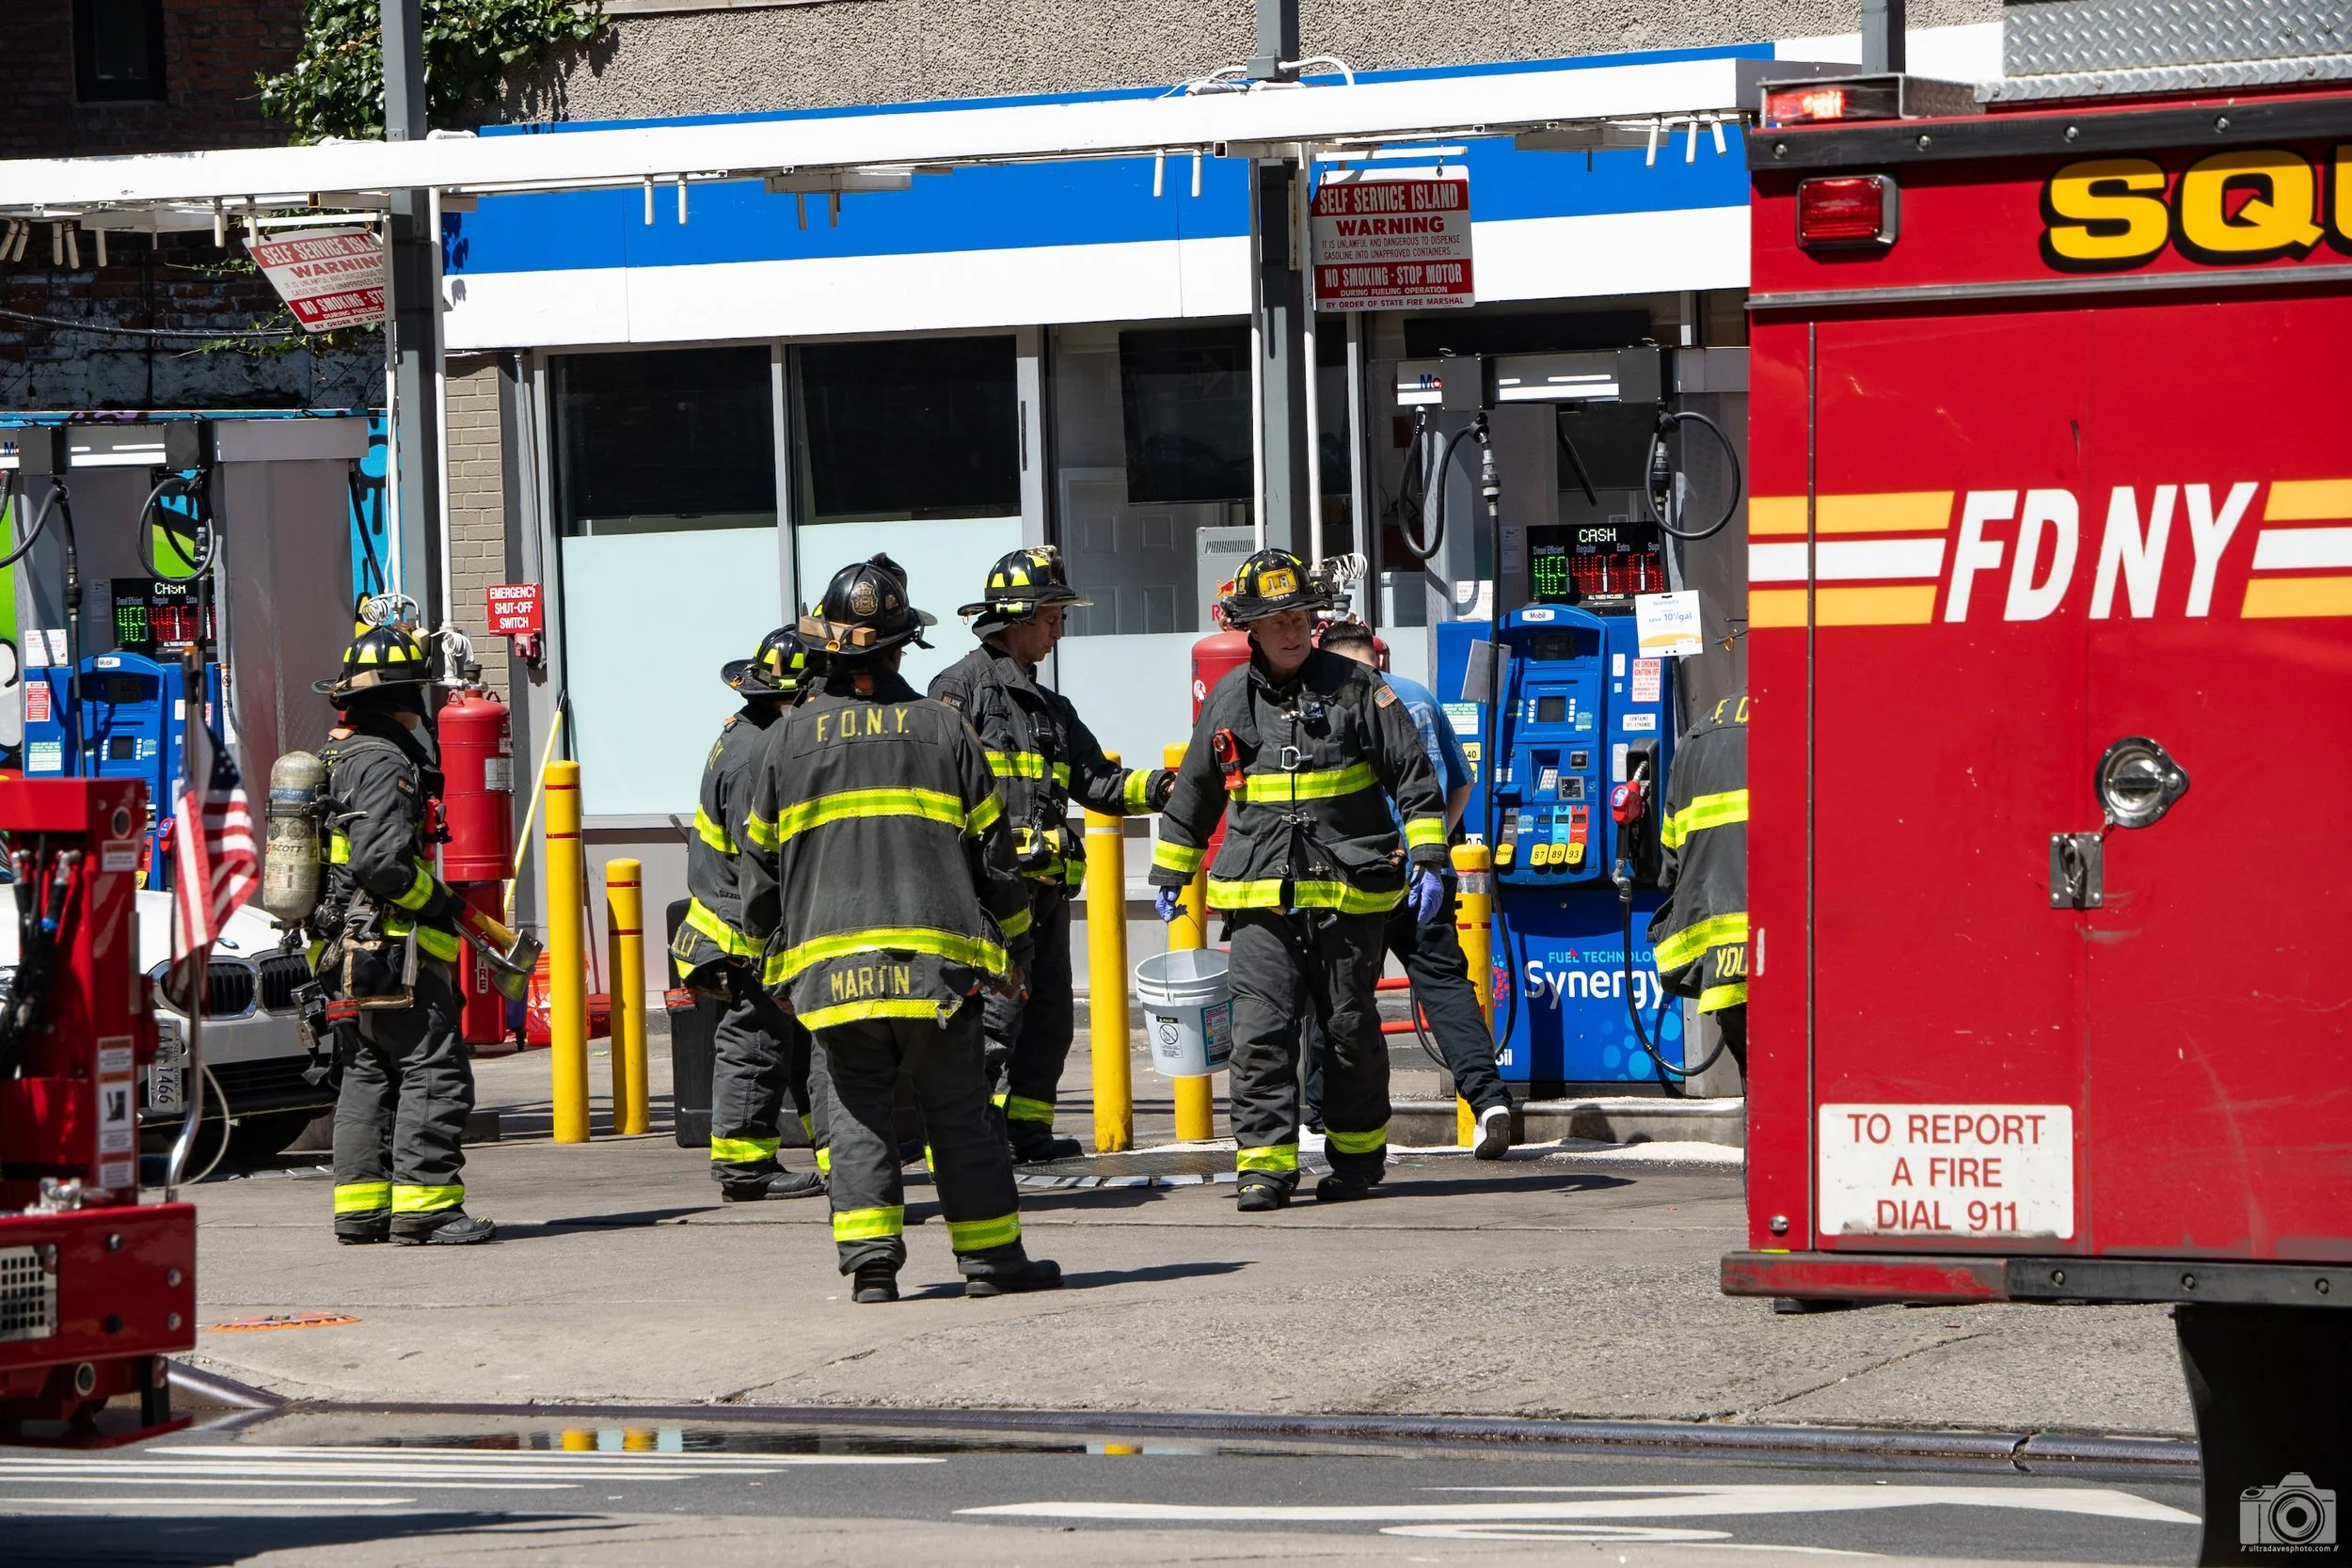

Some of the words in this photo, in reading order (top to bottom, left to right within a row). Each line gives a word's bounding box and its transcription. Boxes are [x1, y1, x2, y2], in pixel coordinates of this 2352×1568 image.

[1320, 187, 1347, 214] SELF
[1354, 185, 1406, 213] SERVICE
[1411, 182, 1459, 210] ISLAND
[2043, 143, 2352, 267] SQ
[1335, 215, 1445, 237] WARNING
[1322, 241, 1327, 249] IT
[1328, 240, 1335, 248] IS
[1337, 238, 1367, 248] UNLAWFUL
[1370, 237, 1382, 247] AND
[1383, 236, 1419, 246] DANGEROUS
[1421, 235, 1430, 245] TO
[1431, 234, 1460, 245] DISPENSE
[261, 245, 294, 265] SELF
[293, 237, 349, 261] SERVICE
[344, 234, 383, 254] ISLA
[1324, 250, 1353, 261] GASOLINE
[1355, 249, 1369, 259] INTO
[1371, 247, 1410, 259] UNAPPROVED
[1412, 246, 1451, 257] CONTAINERS
[300, 277, 329, 287] UNLAWFUL
[342, 270, 376, 281] DANGEROUS
[1325, 268, 1339, 288] NO
[1343, 267, 1389, 288] SMOKING
[1396, 265, 1422, 285] STOP
[1425, 263, 1463, 284] MOTOR
[291, 287, 321, 296] GASOLINE
[322, 284, 336, 293] INTO
[336, 278, 374, 291] UNAPPROVED
[1340, 289, 1369, 297] DURING
[1371, 287, 1402, 295] FUELING
[1404, 285, 1448, 294] OPERATION
[299, 299, 318, 316] NO
[317, 293, 366, 313] SMOKING
[1326, 301, 1336, 309] BY
[1339, 300, 1364, 309] ORDER
[1367, 299, 1377, 308] OF
[1426, 296, 1464, 305] MARSHAL
[323, 310, 351, 320] DURING
[353, 306, 382, 316] FUELING
[326, 319, 351, 327] ORDER
[1579, 528, 1617, 543] CASH
[1533, 546, 1547, 555] Diesel
[1576, 544, 1596, 555] Regular
[1616, 543, 1630, 552] Extra
[1944, 482, 2259, 624] FDNY
[1267, 576, 1289, 592] 18
[186, 594, 198, 604] Extra
[490, 586, 536, 599] EMERGENCY
[494, 601, 533, 614] SHUT-OFF
[500, 616, 529, 629] SWITCH
[1530, 611, 1547, 620] Mobil
[1548, 950, 1580, 964] FUEL
[831, 965, 910, 1002] MARTIN
[1524, 960, 1664, 1009] Synergy
[1847, 1114, 1891, 1144] TO
[1908, 1114, 2045, 1145] REPORT
[1891, 1157, 1913, 1186] A
[1930, 1158, 2002, 1187] FIRE
[1876, 1199, 1951, 1230] DIAL
[1967, 1200, 2017, 1231] 911
